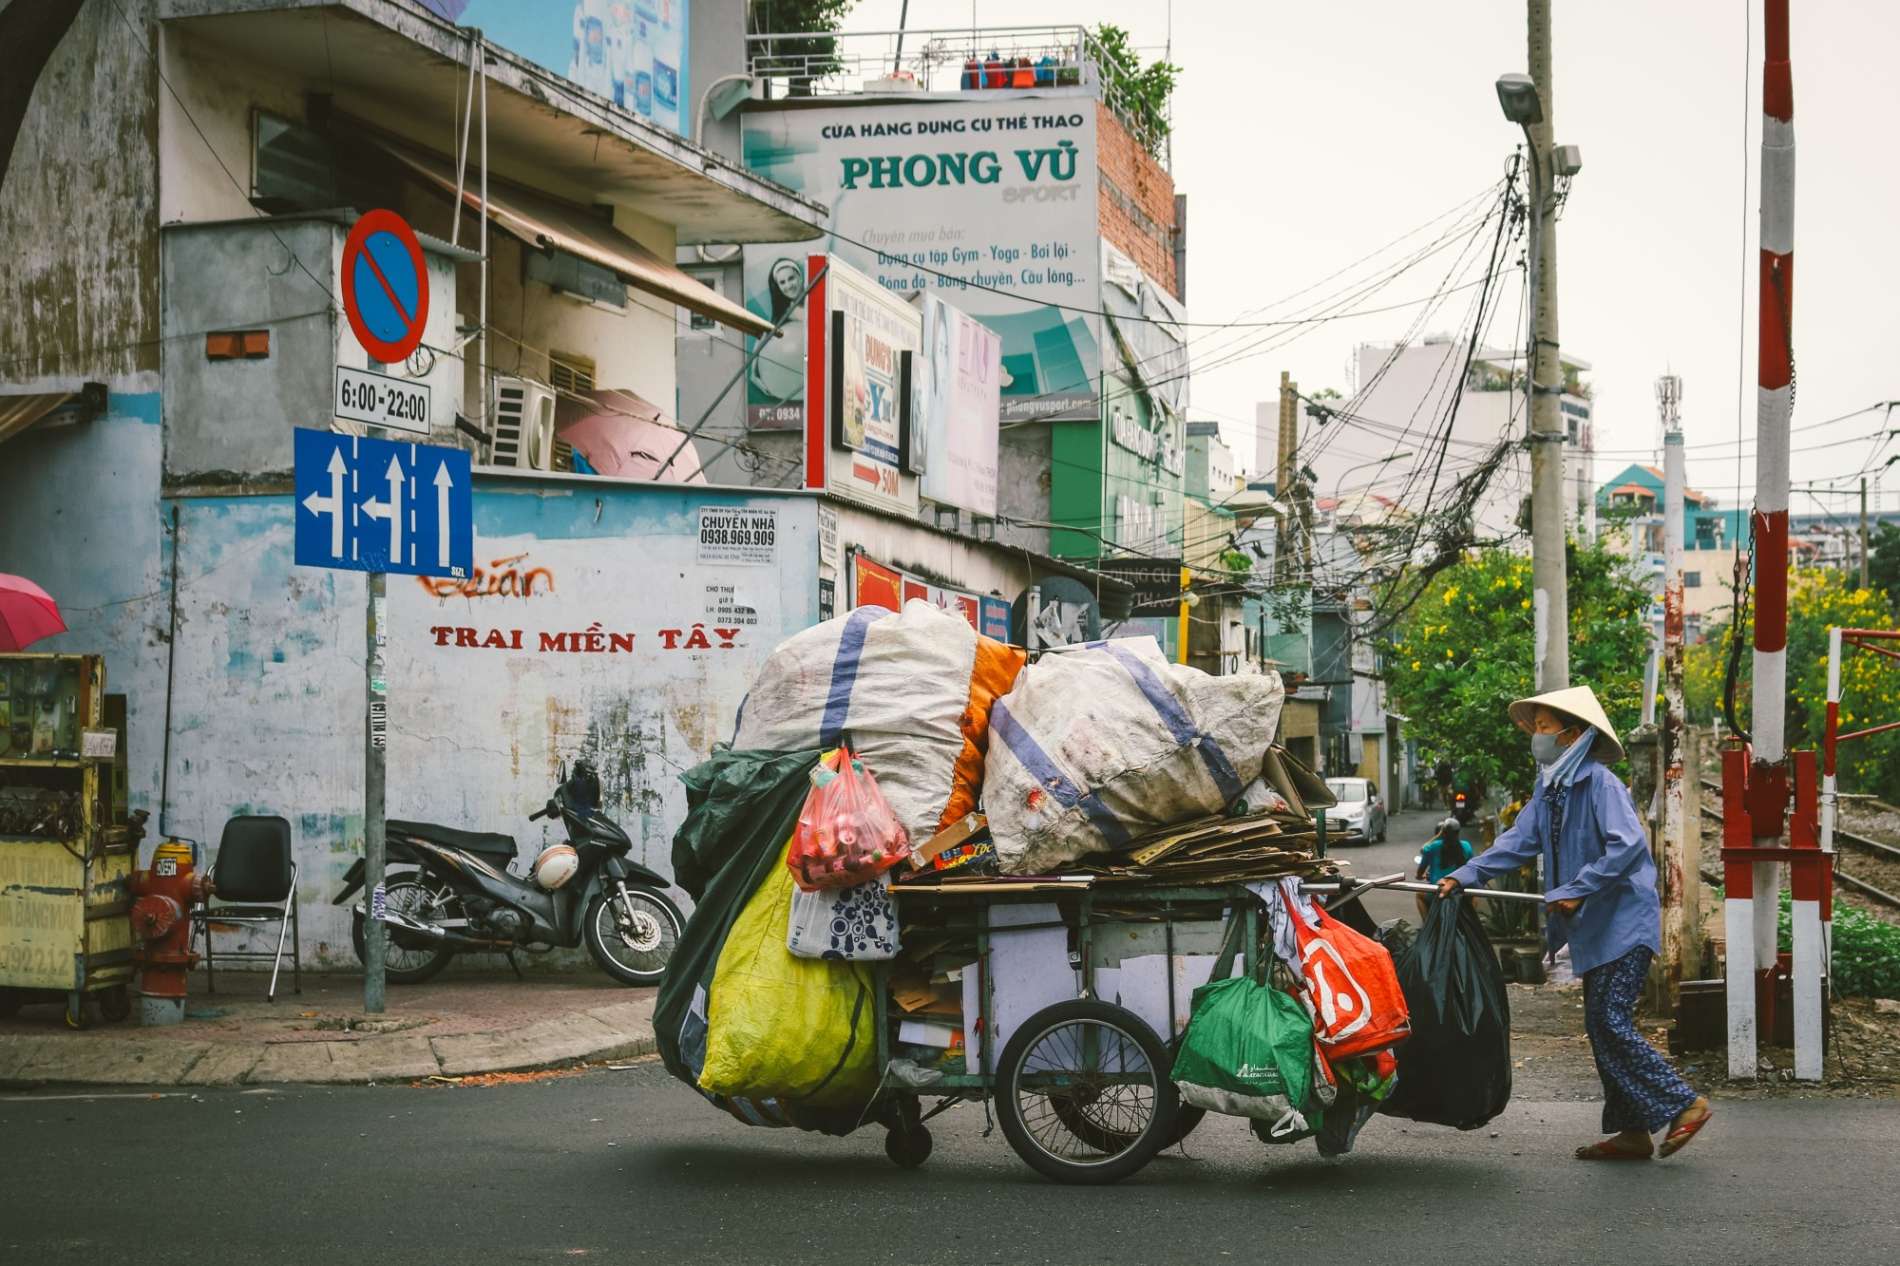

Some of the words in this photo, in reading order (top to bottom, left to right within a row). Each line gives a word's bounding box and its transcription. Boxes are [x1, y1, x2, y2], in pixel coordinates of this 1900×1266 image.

[1032, 114, 1084, 129] THAO
[840, 151, 1002, 190] PHONG
[1014, 139, 1079, 182] VŨ
[1001, 184, 1081, 203] SPORT
[952, 246, 979, 265] Gym
[990, 245, 1020, 263] Yoga
[700, 528, 775, 546] 0938.969.909
